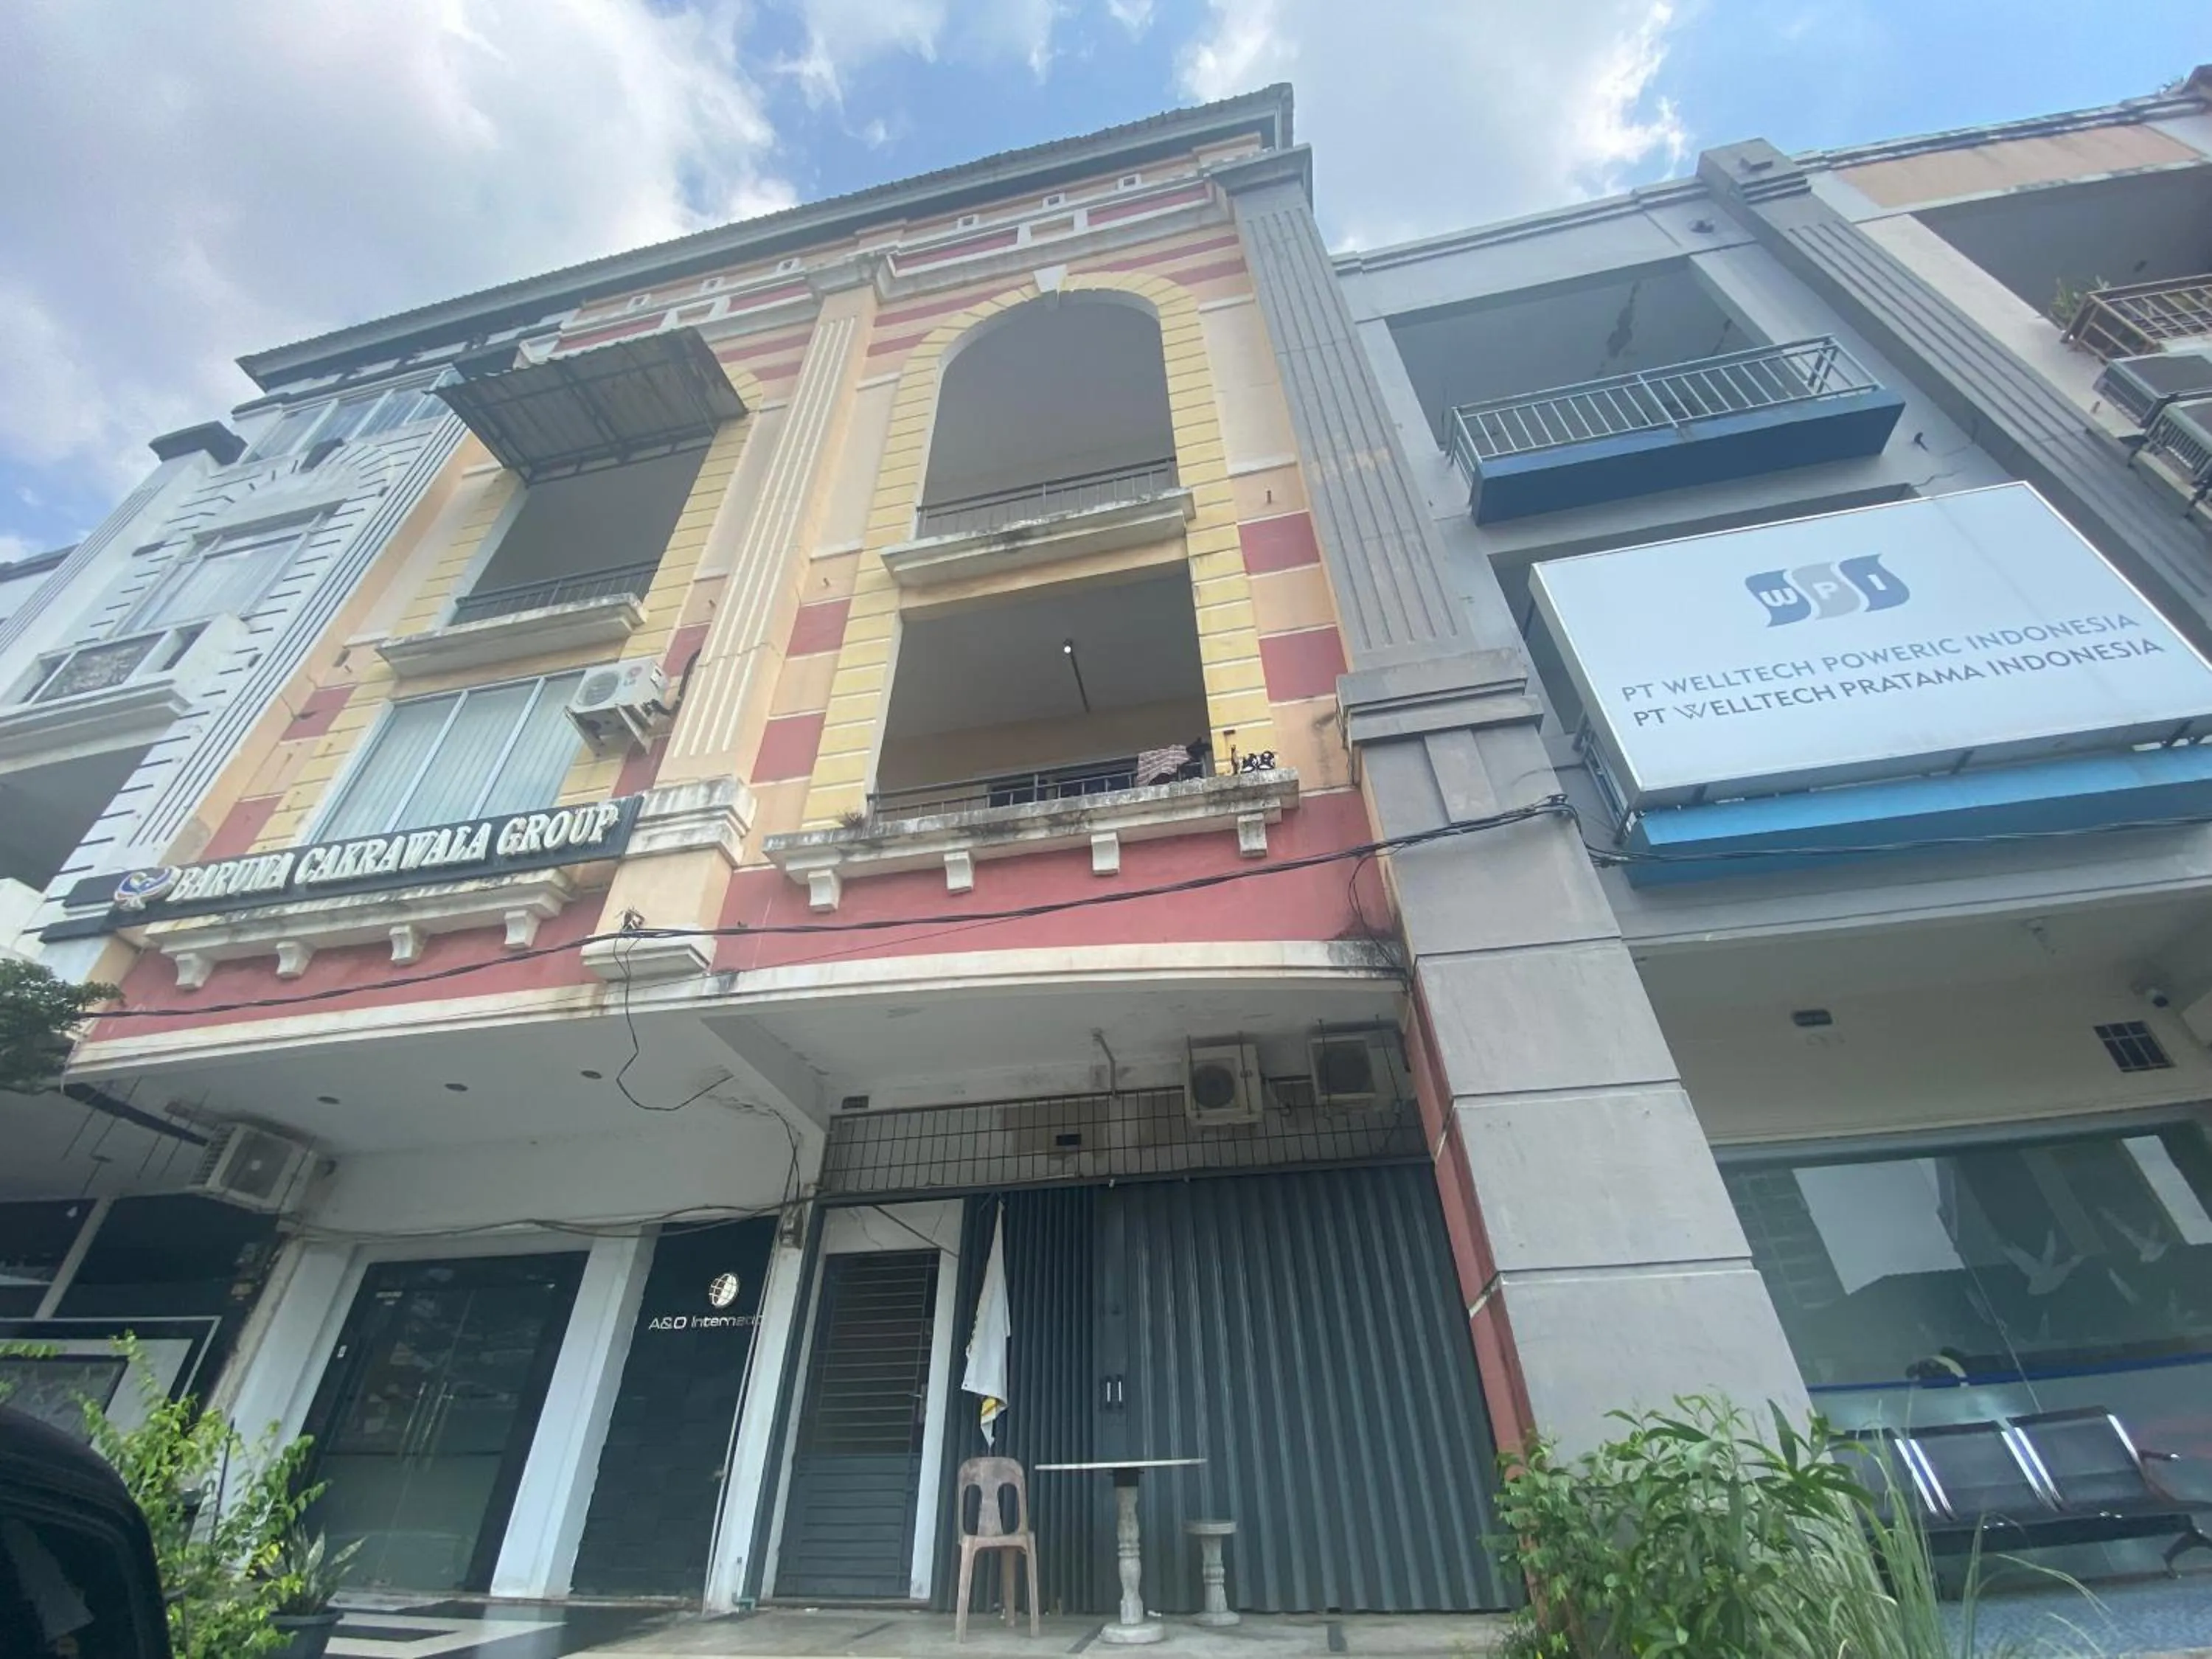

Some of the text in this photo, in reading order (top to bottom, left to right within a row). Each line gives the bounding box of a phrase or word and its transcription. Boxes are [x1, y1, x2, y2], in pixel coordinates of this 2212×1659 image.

[1621, 613, 2140, 701] PT WELLTECH POWERIC INDONESIA
[1633, 638, 2165, 726] PT WELLTECH PRATAMA INDONESIA
[165, 804, 619, 902] BARUNA CAKRAWALA GROUP
[648, 1316, 687, 1330] A&O
